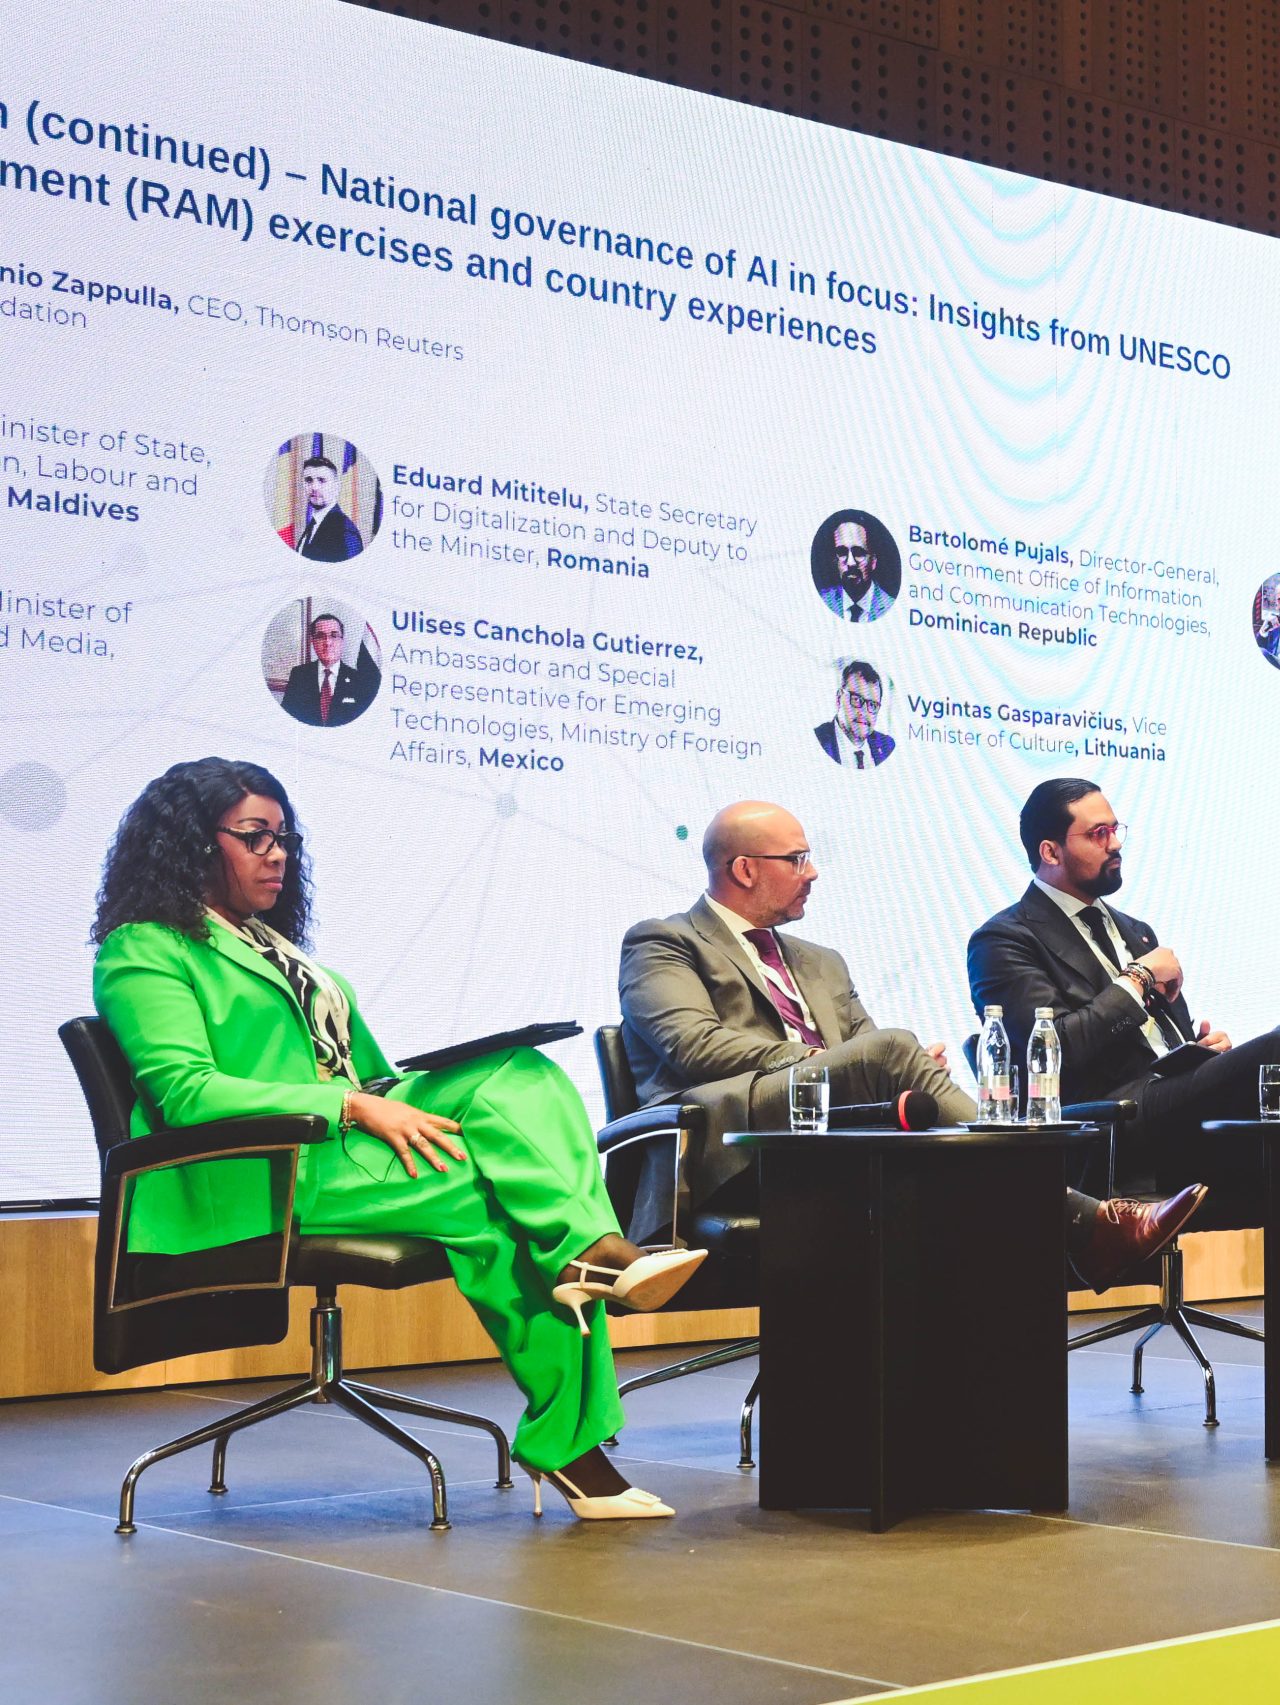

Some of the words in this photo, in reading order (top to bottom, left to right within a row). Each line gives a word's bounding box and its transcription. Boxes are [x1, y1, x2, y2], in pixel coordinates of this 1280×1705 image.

[0, 160, 111, 206] ment
[125, 176, 254, 242] (RAM)
[268, 213, 453, 272] exercises
[466, 253, 532, 288] and
[545, 269, 677, 322] country
[688, 297, 877, 354] experiences
[26, 99, 271, 191] (continued)
[321, 163, 477, 226] National
[490, 206, 694, 270] governance
[705, 248, 737, 279] of
[747, 255, 777, 288] AI
[789, 262, 816, 296] in
[826, 270, 918, 317] focus:
[929, 293, 1041, 342] Insights
[1049, 318, 1110, 356] from
[1119, 333, 1231, 380] UNESCO
[0, 262, 43, 288] nio
[51, 270, 180, 315] Zappulla,
[187, 294, 248, 326] CEO,
[255, 305, 368, 344] Thomson
[376, 327, 464, 361] Reuters
[0, 296, 87, 329] dation
[1, 413, 90, 448] inister
[98, 429, 128, 452] of
[134, 433, 211, 467] State,
[37, 454, 138, 488] Labour
[145, 474, 198, 496] and
[393, 464, 483, 496] Eduard
[491, 478, 589, 513] Mititelu,
[595, 492, 653, 519] State
[659, 501, 758, 538] Secretary
[7, 486, 140, 523] Maldives
[391, 494, 425, 519] for
[433, 501, 586, 540] Digitalization
[593, 527, 635, 547] and
[643, 529, 721, 562] Deputy
[726, 542, 748, 562] to
[391, 528, 433, 553] the
[441, 534, 540, 568] Minister,
[547, 547, 650, 579] Romania
[908, 552, 1024, 585] Government
[1028, 569, 1080, 593] Office
[1083, 577, 1101, 595] of
[1105, 579, 1202, 608] Information
[909, 524, 1009, 556] Bartolomé
[1014, 540, 1074, 567] Pujals,
[1079, 548, 1220, 587] Director-General,
[0, 590, 96, 620] inister
[104, 601, 133, 624] of
[908, 583, 944, 602] and
[949, 585, 1094, 621] Communication
[1097, 603, 1211, 637] Technologies,
[909, 608, 1012, 637] Dominican
[1018, 621, 1097, 647] Republic
[21, 627, 115, 659] Media,
[392, 610, 466, 637] Ulises
[473, 619, 585, 650] Canchola
[592, 631, 704, 665] Gutierrez,
[390, 642, 541, 676] Ambassador
[547, 660, 591, 681] and
[598, 662, 675, 688] Special
[392, 673, 571, 710] Representative
[576, 689, 607, 712] for
[614, 693, 721, 728] Emerging
[907, 694, 992, 720] Vygintas
[997, 703, 1128, 734] Gasparavičius,
[1132, 716, 1167, 736] Vice
[389, 740, 472, 769] Affairs,
[479, 747, 565, 772] Mexico
[390, 707, 554, 743] Technologies,
[561, 722, 650, 753] Ministry
[655, 729, 678, 750] of
[682, 731, 762, 761] Foreign
[908, 722, 982, 746] Minister
[986, 729, 1006, 748] of
[1008, 731, 1080, 758] Culture,
[1084, 737, 1166, 762] Lithuania
